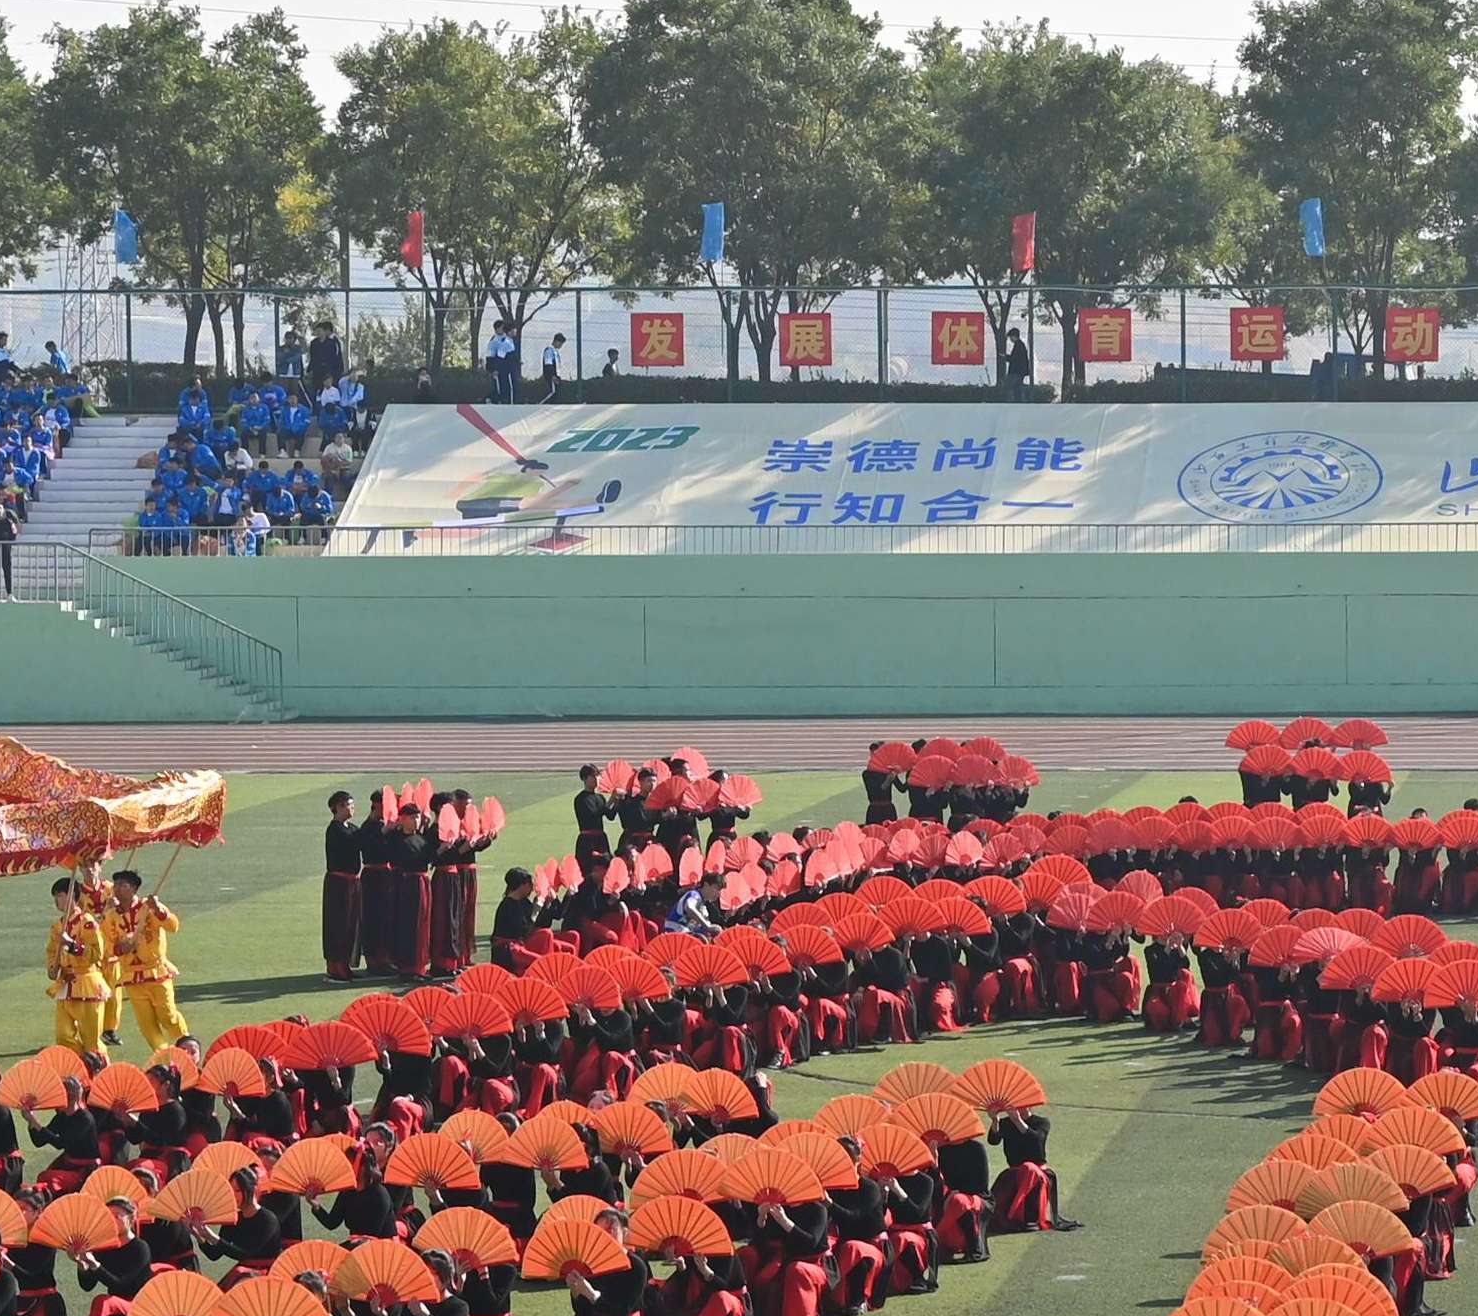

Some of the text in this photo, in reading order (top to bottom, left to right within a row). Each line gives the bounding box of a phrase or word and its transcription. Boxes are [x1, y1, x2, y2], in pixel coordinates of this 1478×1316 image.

[640, 314, 1434, 360] 发 展 体 育 运 动
[545, 425, 701, 453] 2023
[761, 436, 1086, 473] 崇德尚能
[748, 488, 1074, 525] 行知合一
